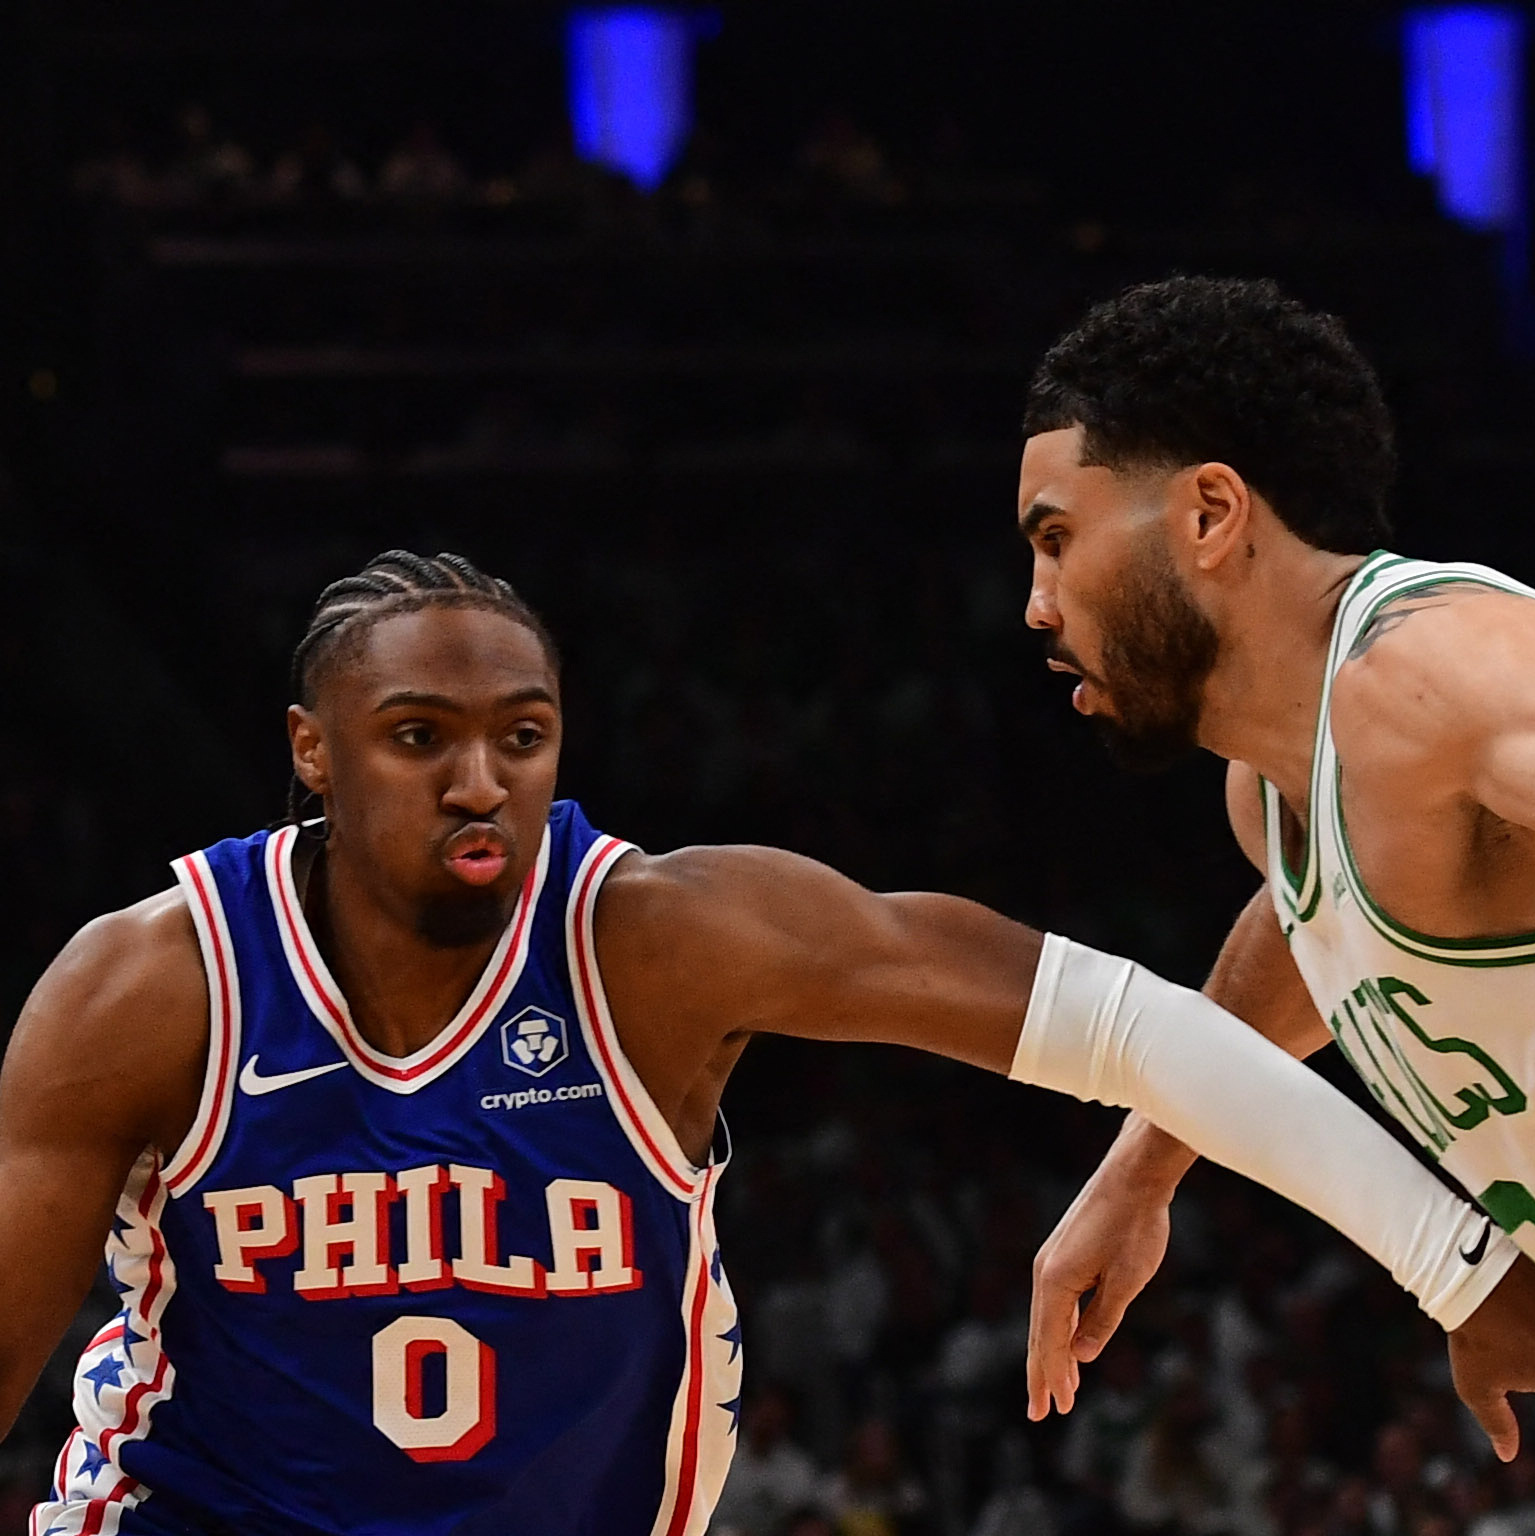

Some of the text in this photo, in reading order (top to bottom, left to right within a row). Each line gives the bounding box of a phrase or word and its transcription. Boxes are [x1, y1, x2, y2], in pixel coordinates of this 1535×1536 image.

[480, 1080, 603, 1111] crypto.com
[203, 1163, 643, 1300] PHILA
[372, 1315, 497, 1463] 0
